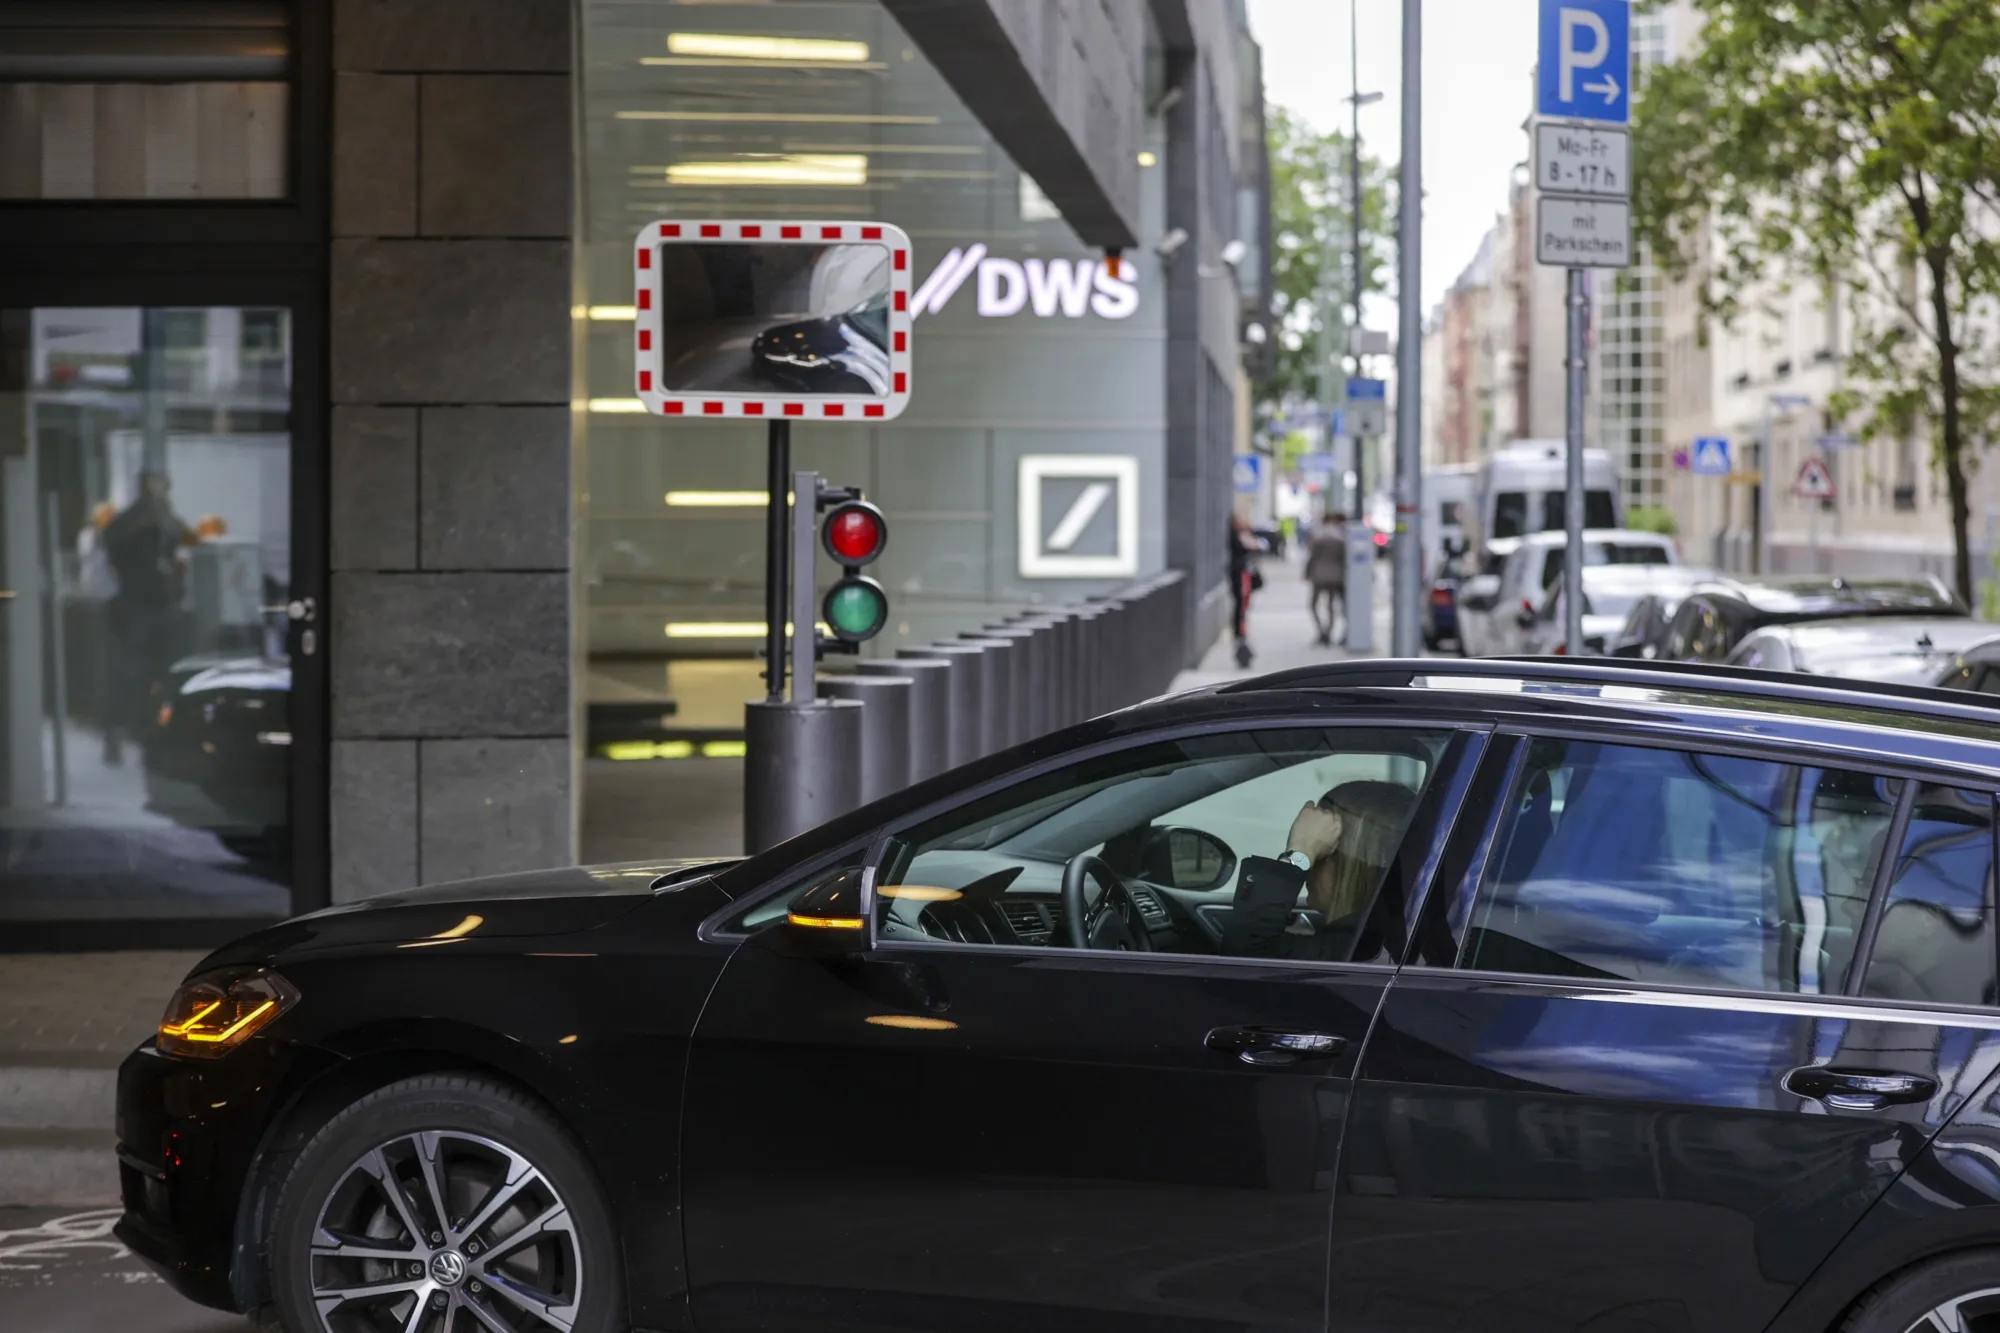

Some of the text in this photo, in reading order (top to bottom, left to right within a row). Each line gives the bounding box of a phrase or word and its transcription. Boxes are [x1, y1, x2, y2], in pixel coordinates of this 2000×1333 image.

[1559, 8, 1609, 102] P
[1572, 215, 1596, 231] mit
[1544, 232, 1623, 254] Parkschein
